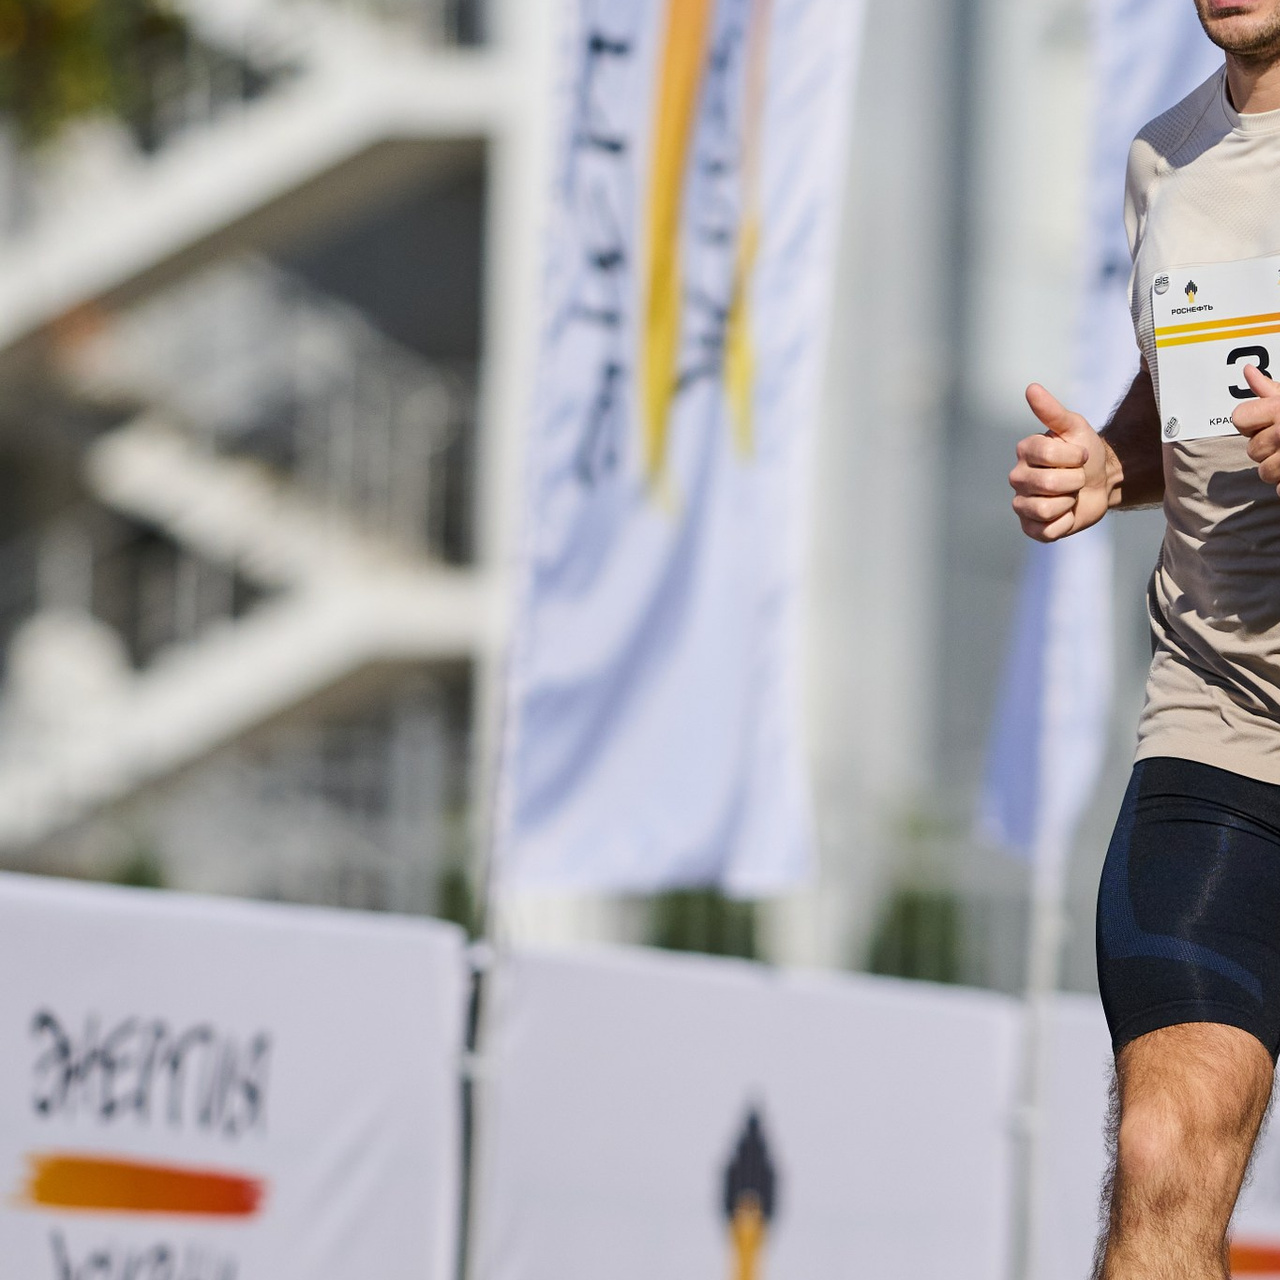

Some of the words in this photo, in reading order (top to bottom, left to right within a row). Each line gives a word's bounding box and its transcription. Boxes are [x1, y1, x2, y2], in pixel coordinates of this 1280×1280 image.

[1171, 305, 1214, 316] РОСНЕФТЬ
[1226, 345, 1273, 400] 3
[31, 1006, 272, 1138] ЭНЕРГИЯ
